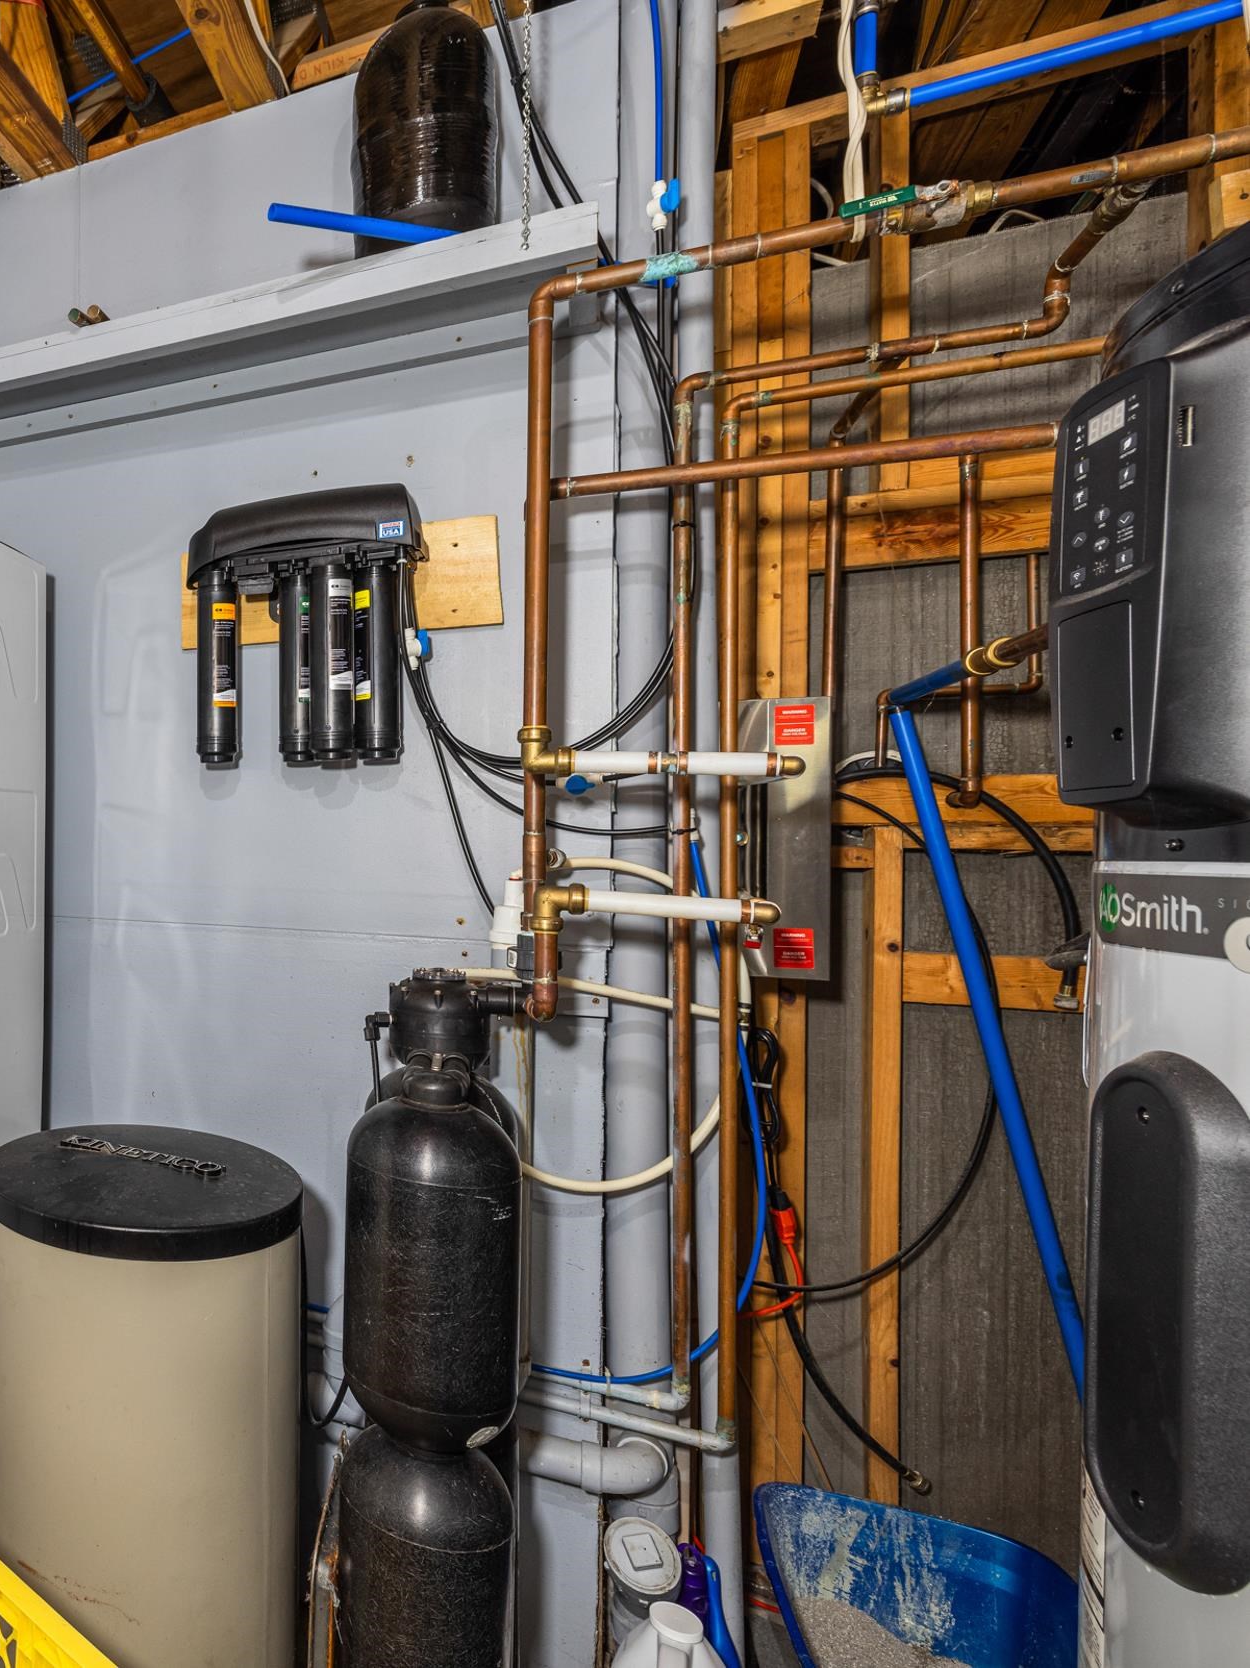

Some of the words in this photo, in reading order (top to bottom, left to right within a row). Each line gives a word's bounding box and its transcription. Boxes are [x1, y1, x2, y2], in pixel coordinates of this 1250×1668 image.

[313, 56, 344, 75] KILN
[382, 528, 400, 537] USA
[59, 1134, 225, 1178] KINETICO
